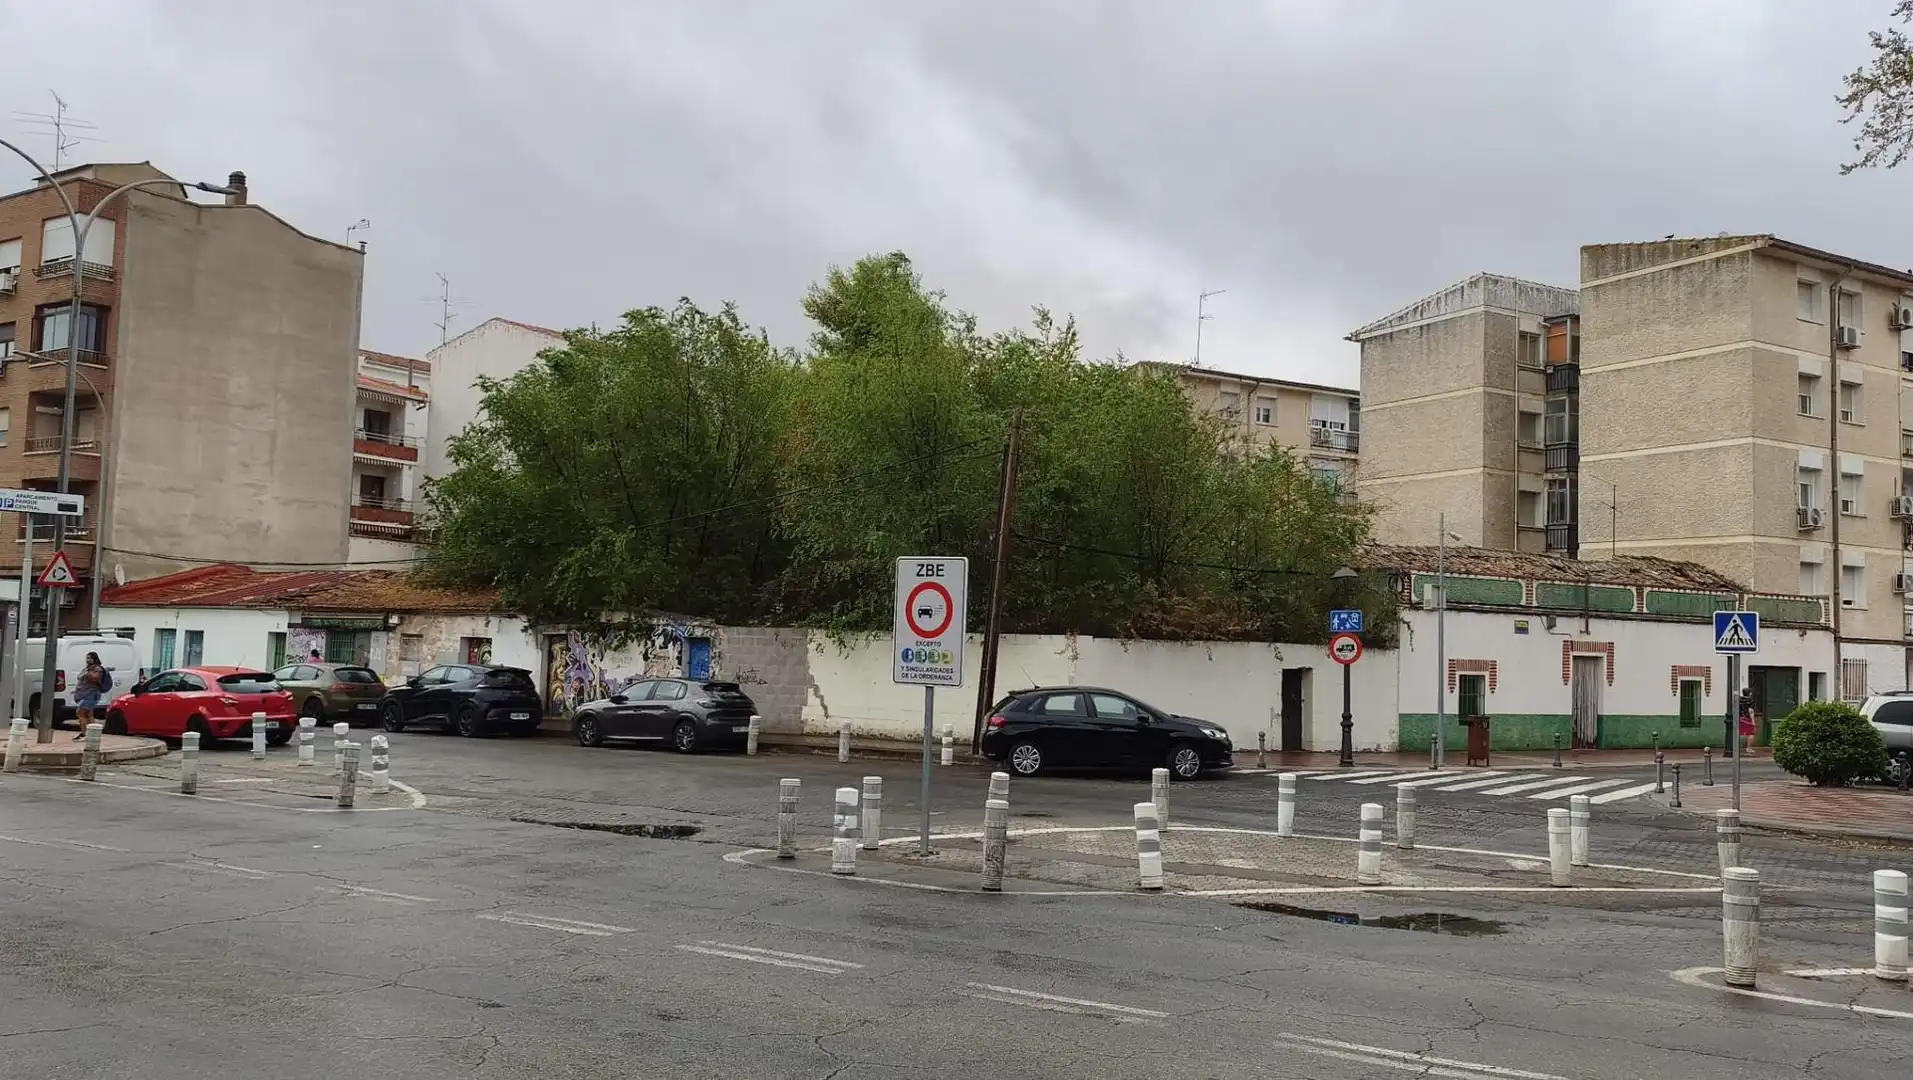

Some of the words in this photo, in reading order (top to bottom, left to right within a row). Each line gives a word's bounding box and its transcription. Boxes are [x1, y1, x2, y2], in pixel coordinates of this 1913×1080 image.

[14, 503, 40, 511] CENTRAL
[916, 563, 945, 577] ZBE
[905, 665, 954, 674] SINGULARIDADES
